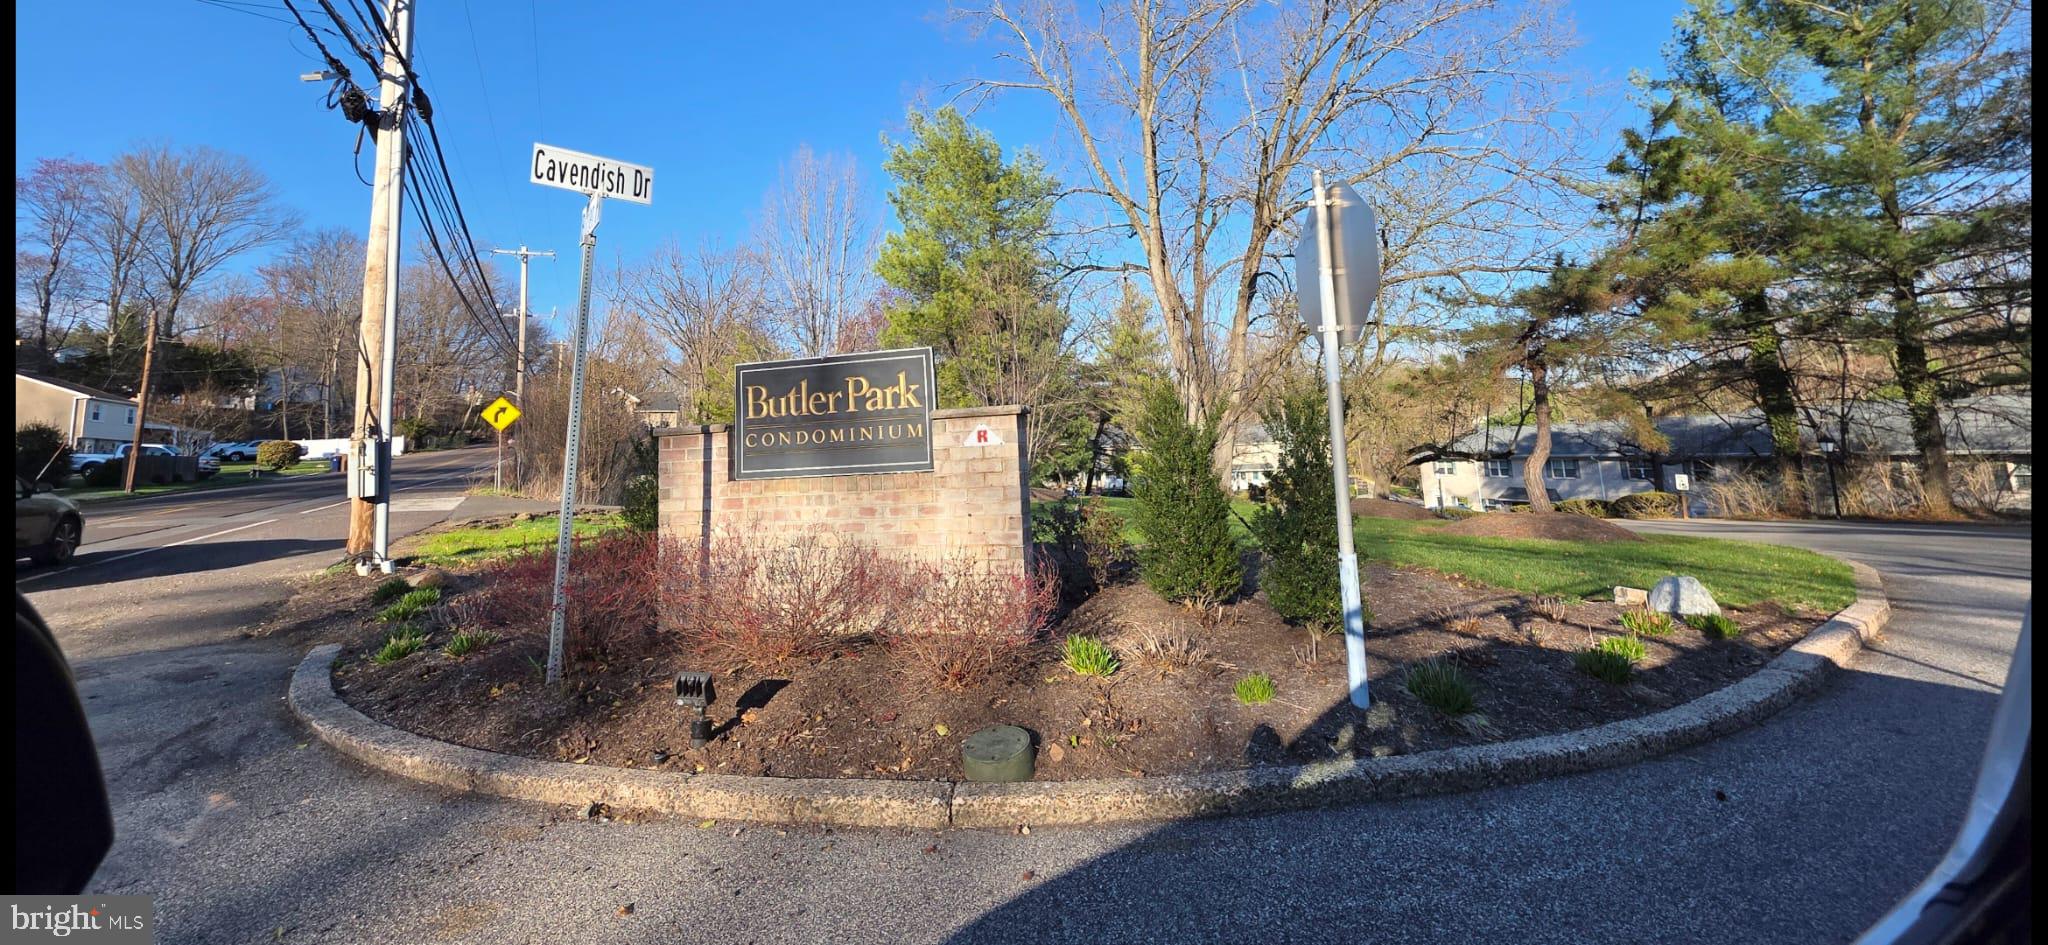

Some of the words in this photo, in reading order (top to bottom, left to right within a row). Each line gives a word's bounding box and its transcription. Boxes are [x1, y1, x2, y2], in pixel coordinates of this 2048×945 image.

[534, 149, 625, 195] Cavendish
[633, 169, 651, 199] Dr
[745, 377, 842, 419] Butler
[844, 370, 922, 412] Park
[745, 423, 924, 448] CONDOMINIUM
[977, 429, 988, 443] R
